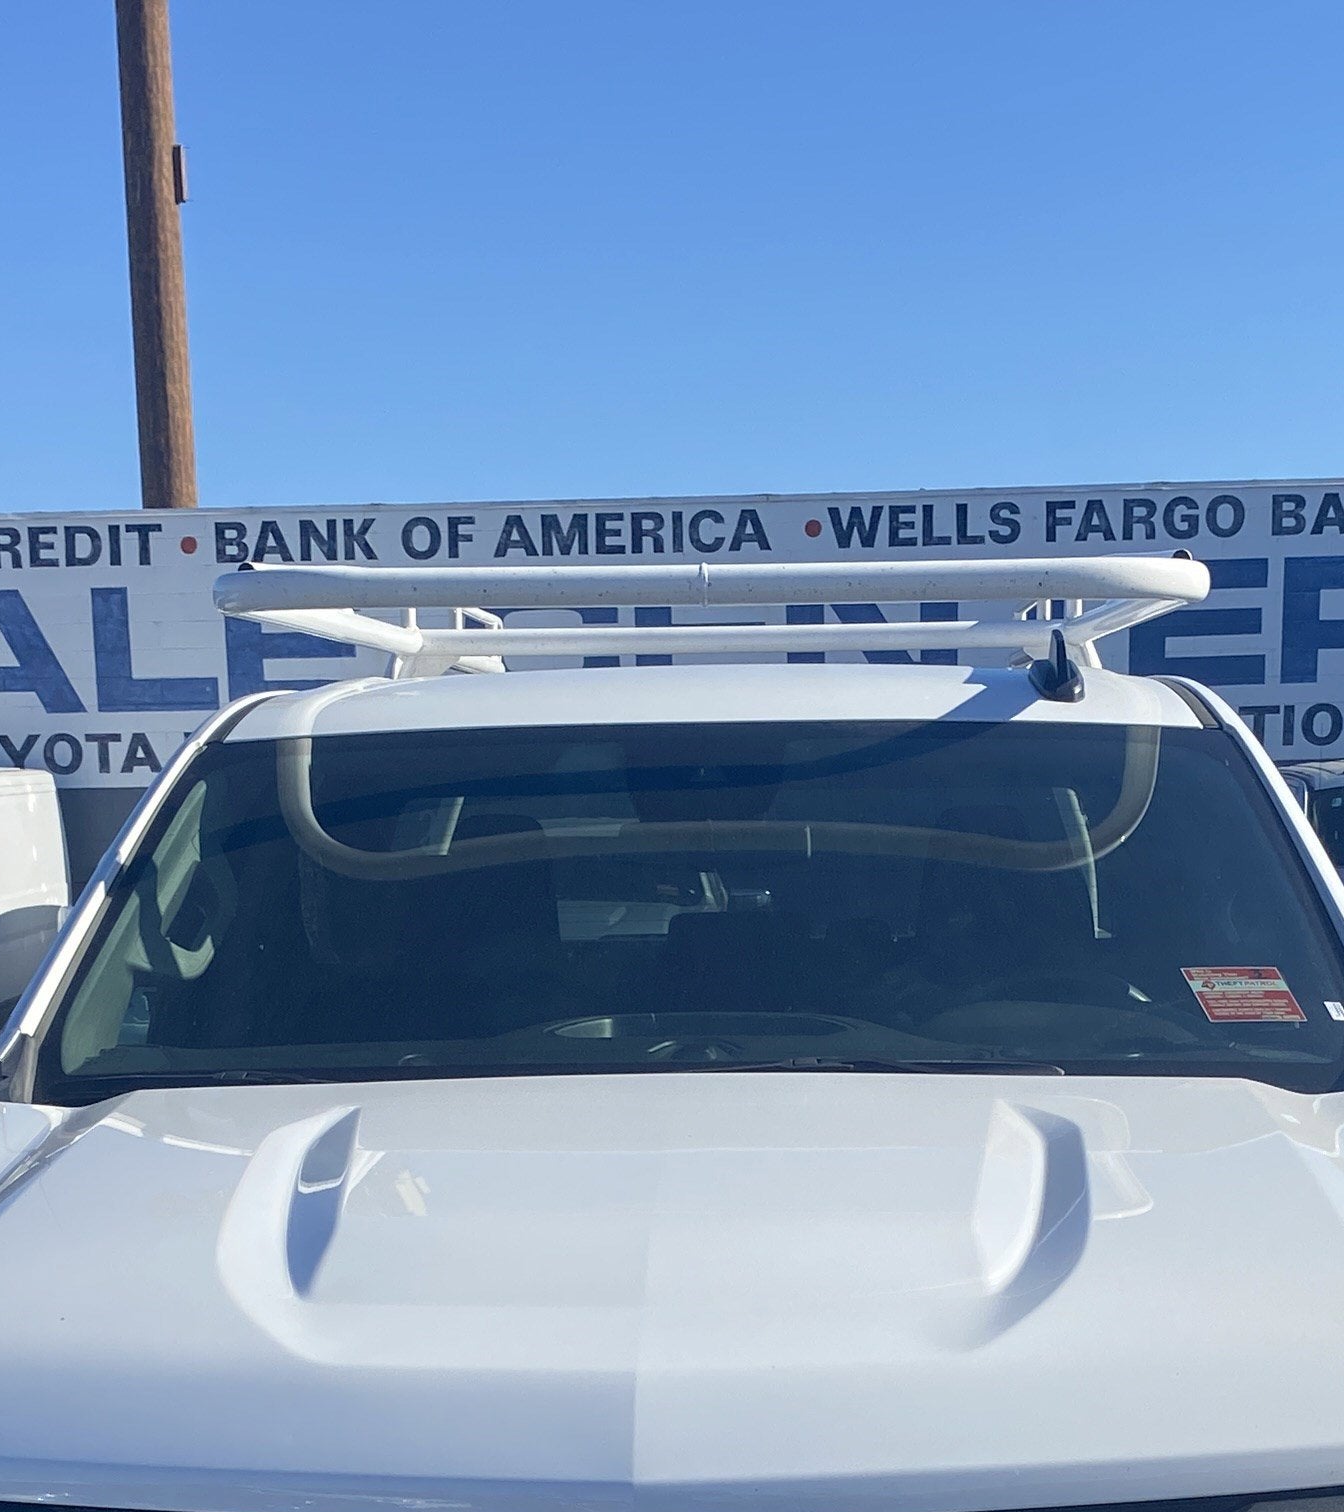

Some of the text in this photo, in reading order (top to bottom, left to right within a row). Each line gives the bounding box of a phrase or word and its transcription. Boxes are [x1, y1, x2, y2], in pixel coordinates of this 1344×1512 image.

[213, 517, 379, 564] BANK
[400, 515, 476, 561] OF
[493, 508, 773, 558] AMERICA
[826, 501, 1021, 549] WELLS
[1045, 494, 1246, 543] FARGO
